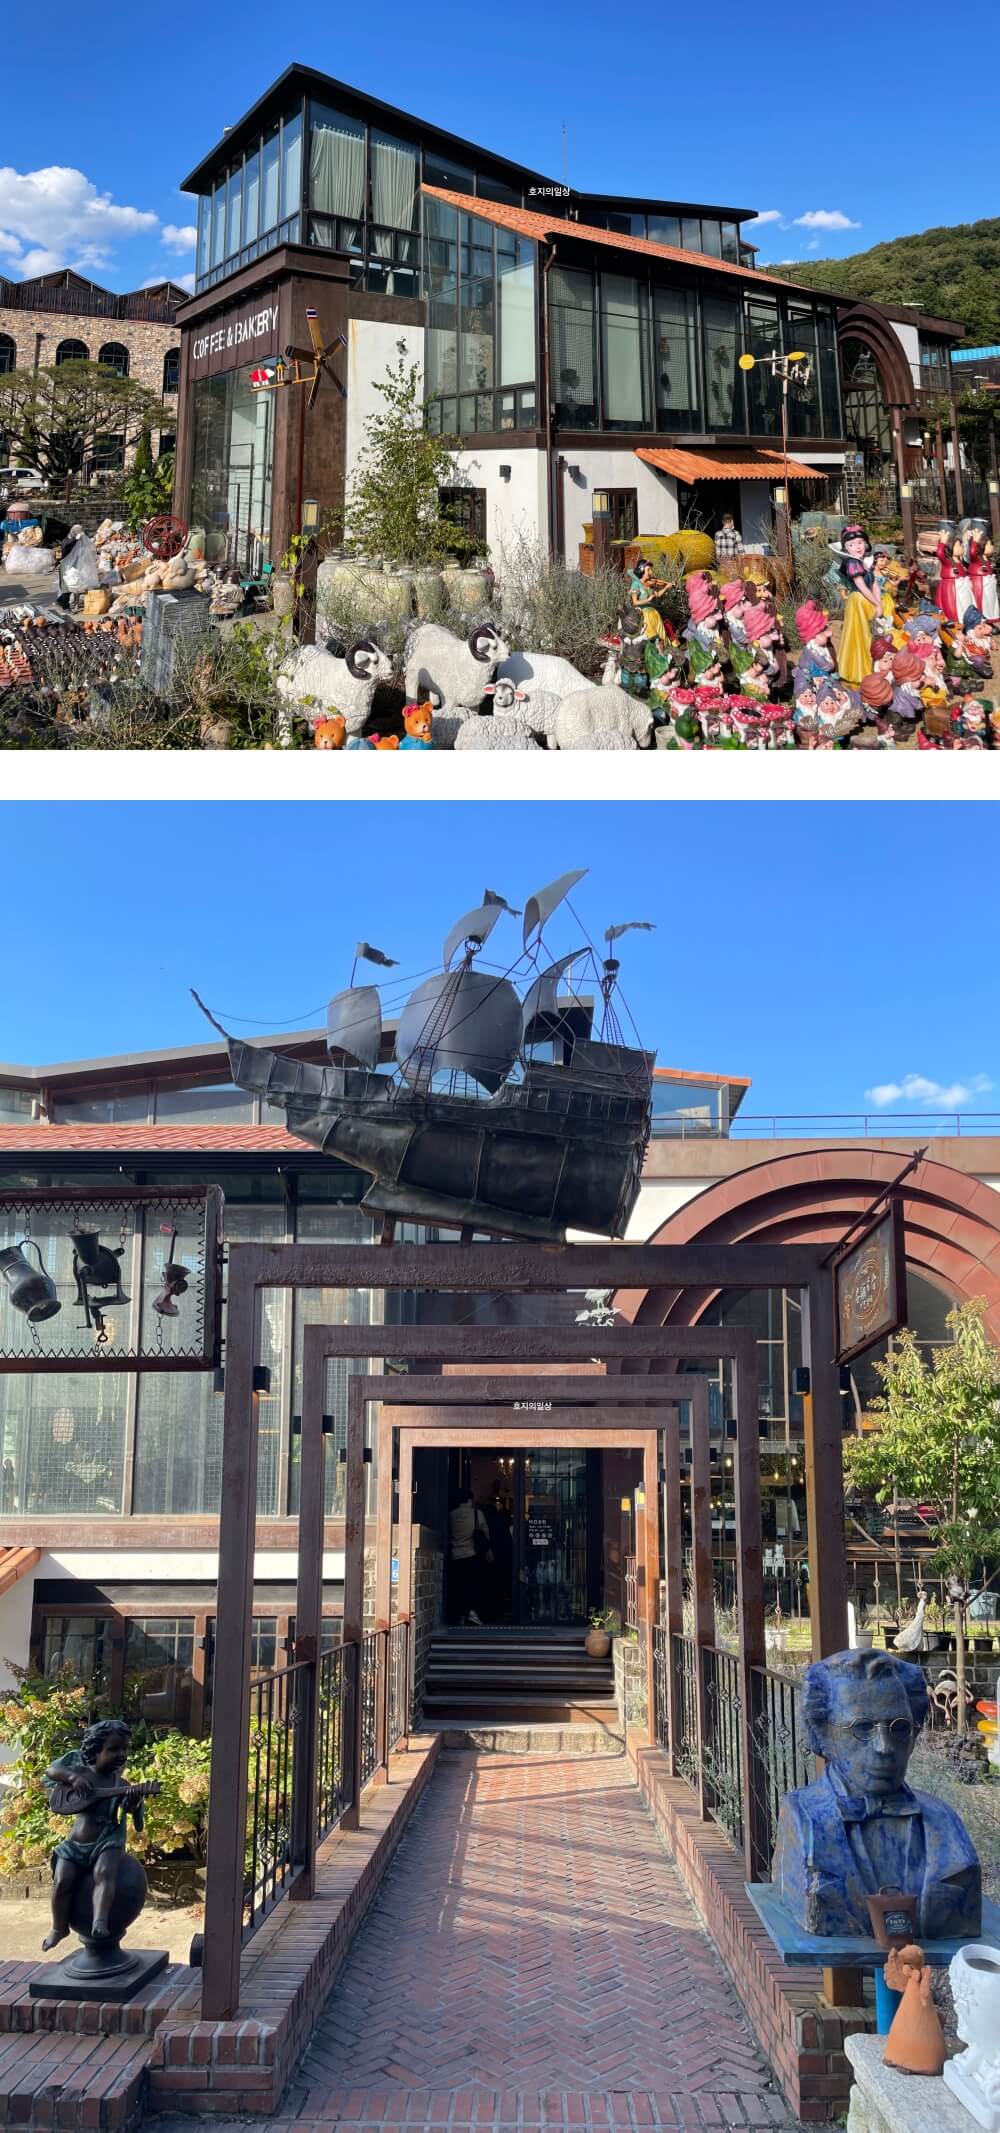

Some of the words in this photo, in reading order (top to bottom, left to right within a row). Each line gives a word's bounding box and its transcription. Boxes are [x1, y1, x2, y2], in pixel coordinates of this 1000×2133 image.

[193, 329, 226, 360] COFFEE
[226, 326, 233, 347] &
[234, 305, 279, 345] BAKERY
